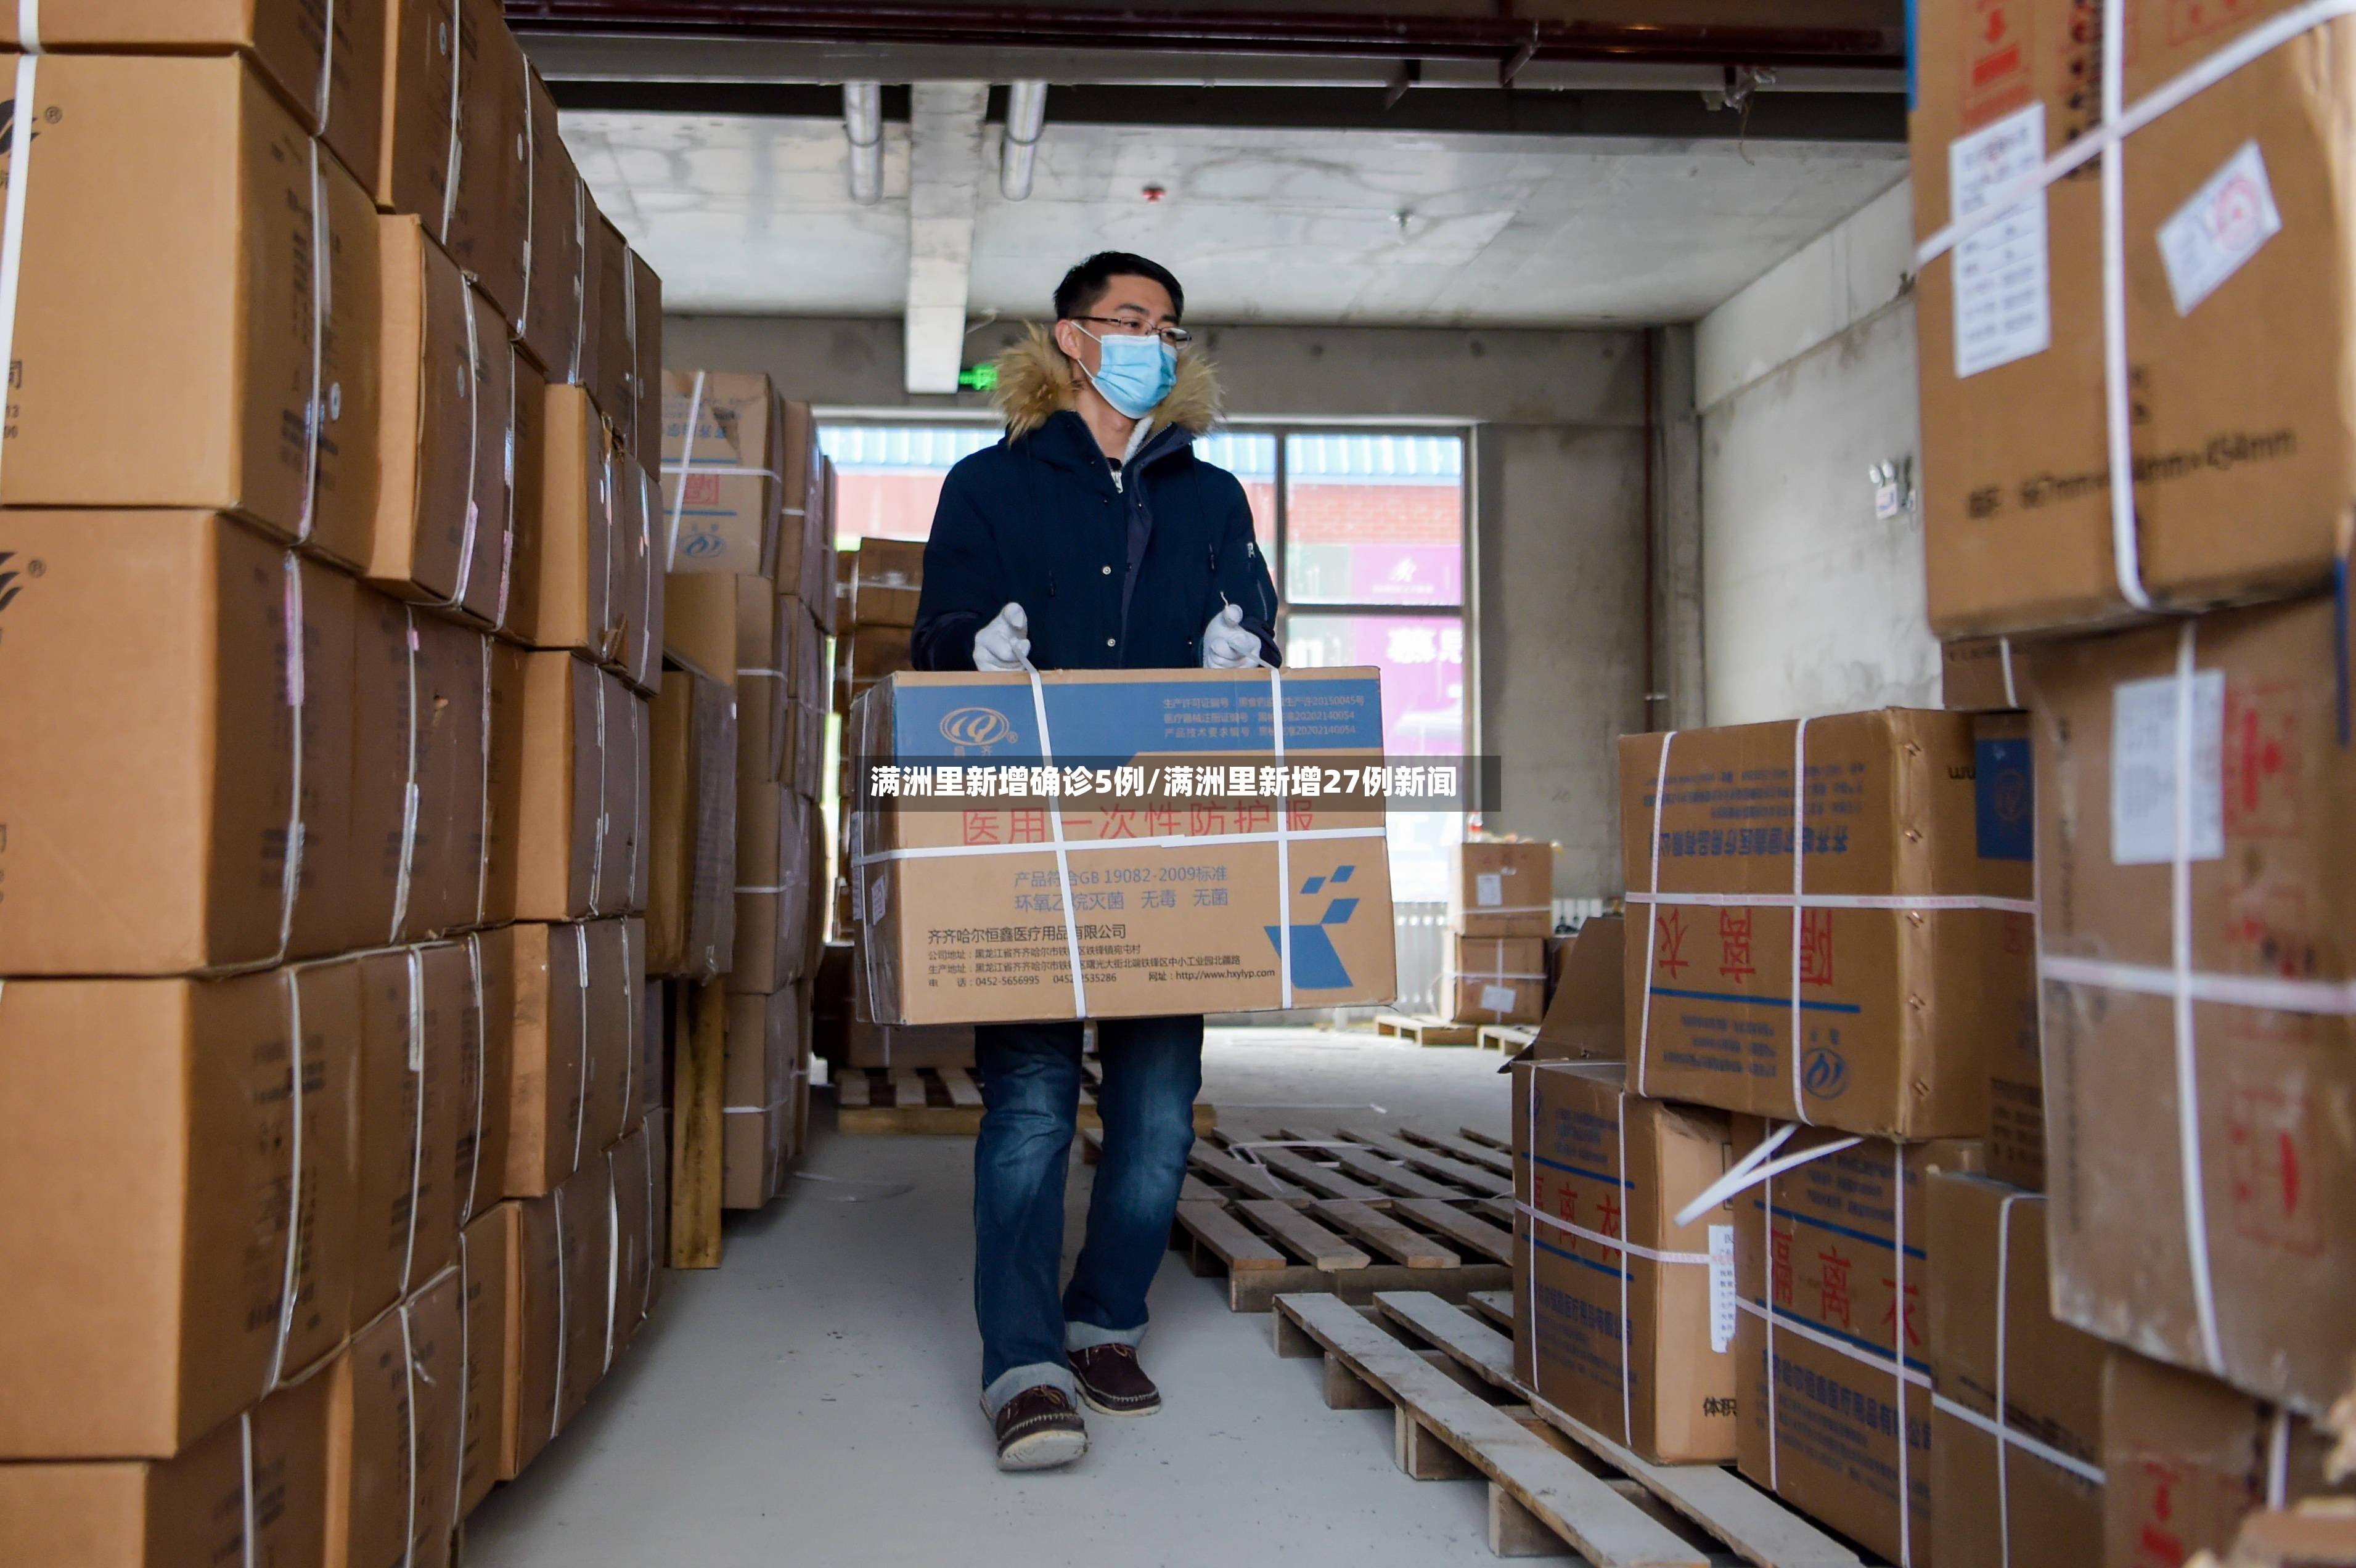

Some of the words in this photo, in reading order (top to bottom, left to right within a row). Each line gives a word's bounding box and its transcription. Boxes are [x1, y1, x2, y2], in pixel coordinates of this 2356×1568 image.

[963, 800, 1313, 846] 医用一次性防护服
[1105, 865, 1227, 883] 19082-2009标准
[1015, 891, 1124, 912] 环氧乙烷灭菌
[1141, 890, 1176, 909] 无毒
[1193, 888, 1228, 907] 无菌
